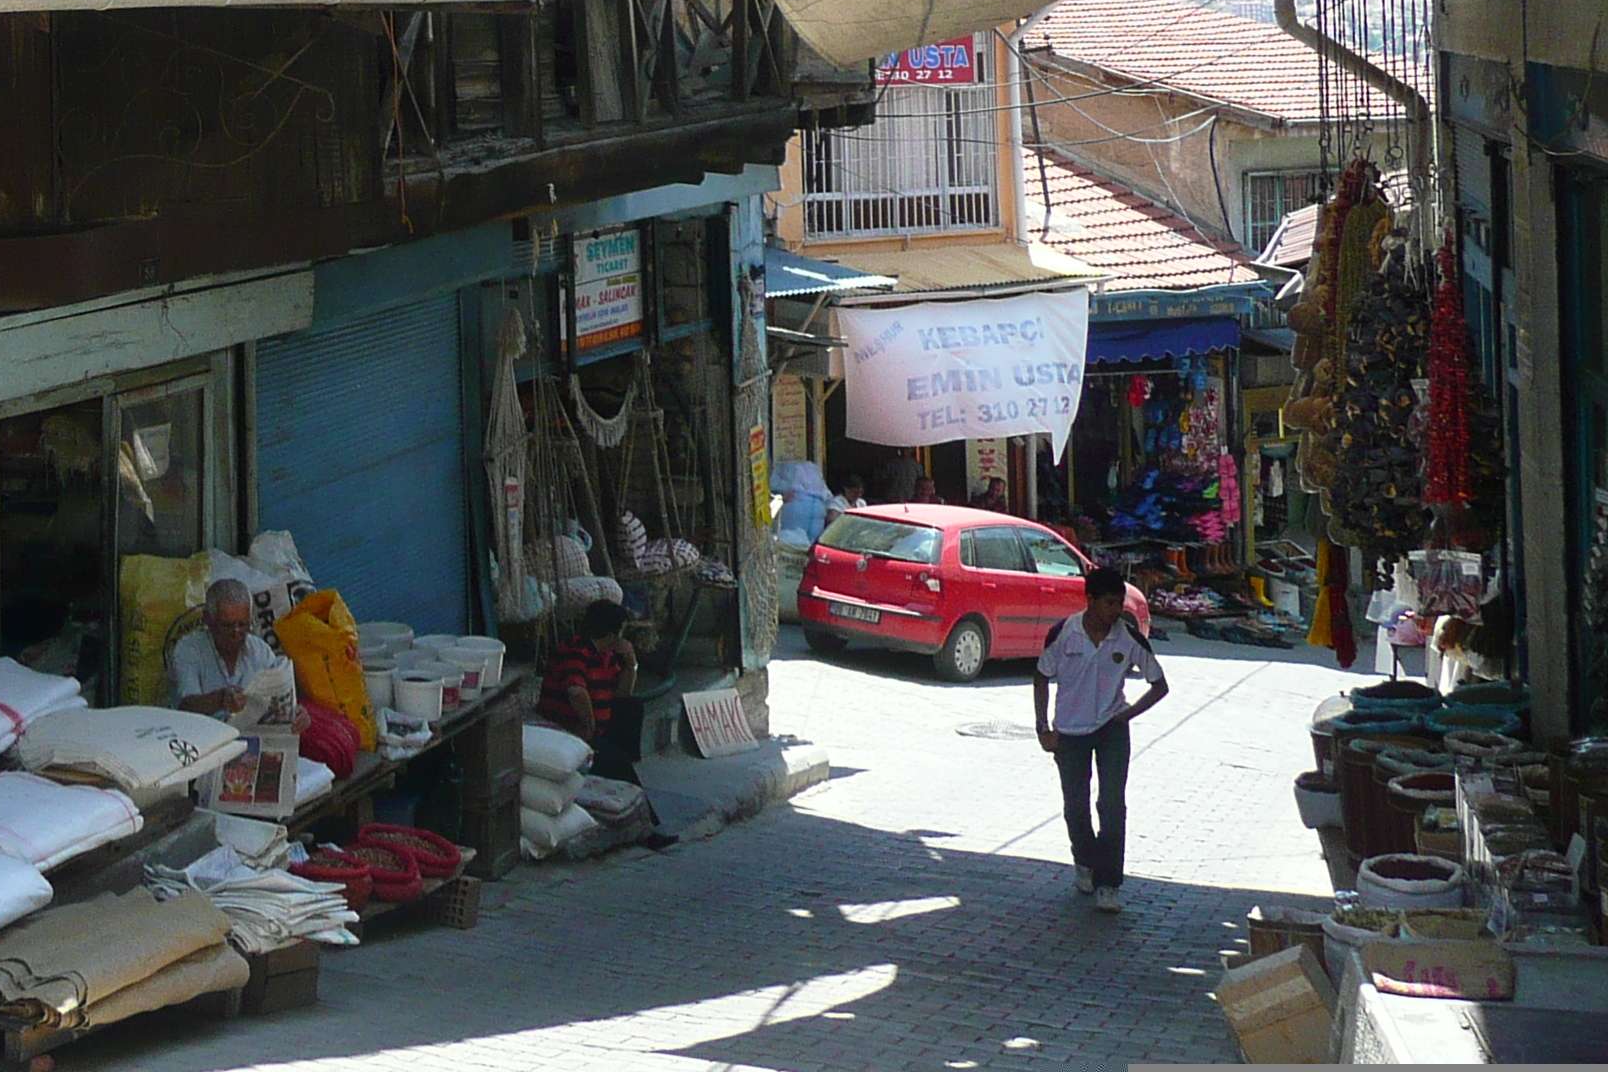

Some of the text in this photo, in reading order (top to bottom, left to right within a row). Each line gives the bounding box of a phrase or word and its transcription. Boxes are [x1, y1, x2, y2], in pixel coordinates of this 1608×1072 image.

[908, 44, 970, 69] USTA
[916, 69, 932, 80] 27
[938, 69, 954, 79] 12
[586, 234, 636, 263] SEYMEN
[1013, 362, 1082, 388] USTA
[916, 395, 1071, 430] TEL: 310 27 12
